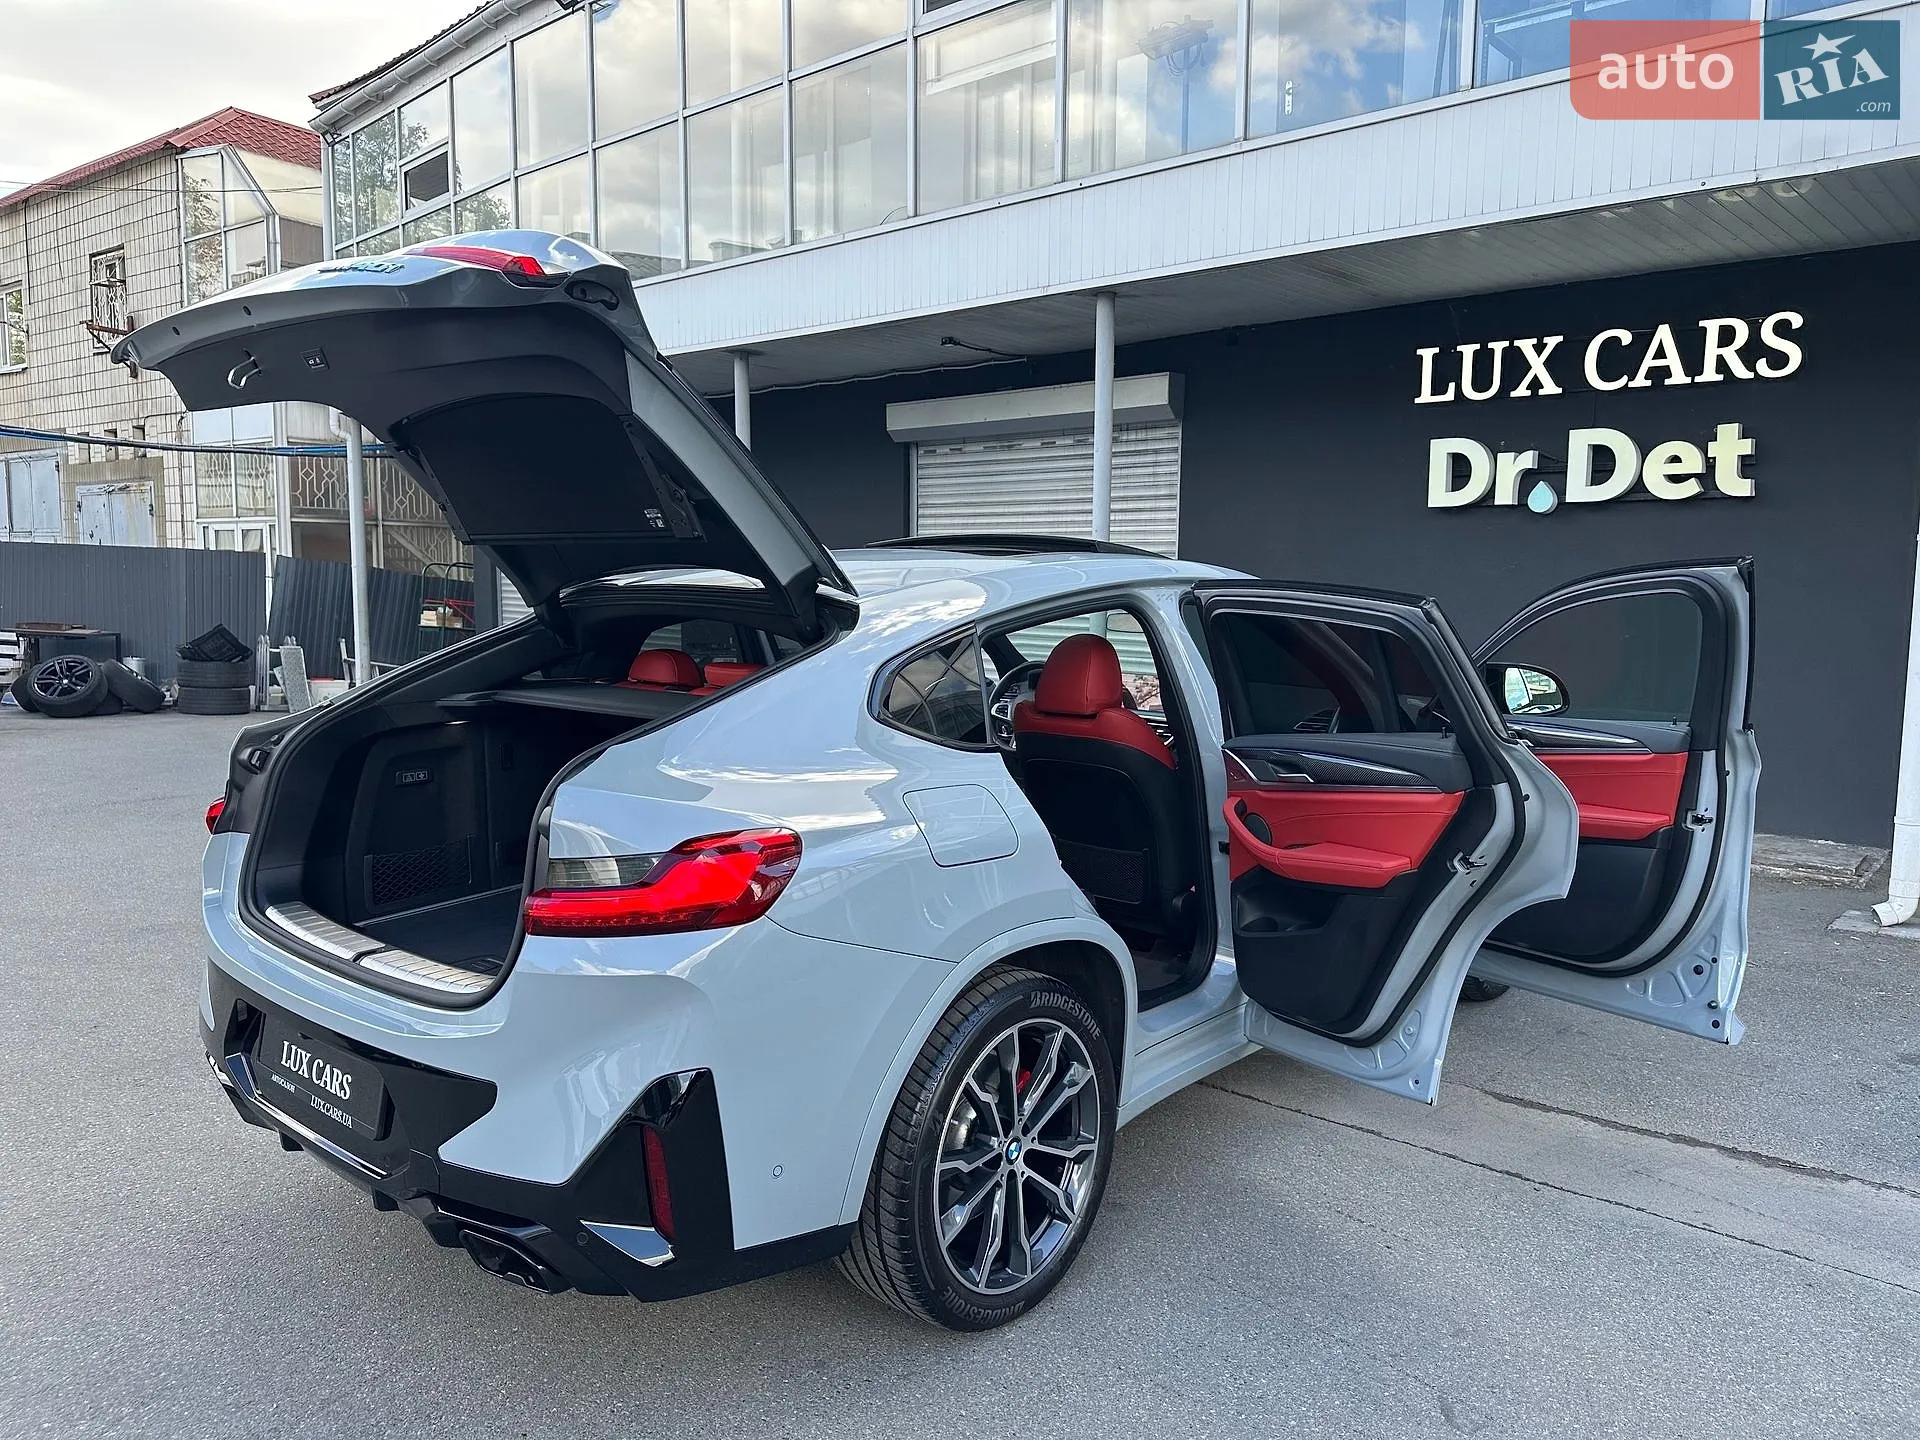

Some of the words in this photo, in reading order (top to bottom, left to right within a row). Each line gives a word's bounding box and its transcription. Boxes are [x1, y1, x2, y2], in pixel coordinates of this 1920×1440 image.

[1414, 335, 1563, 404] LUX
[1584, 311, 1804, 391] CARS
[1030, 991, 1101, 1040] BRIDGESTONE
[281, 1040, 312, 1079] LUX
[312, 1058, 352, 1100] CARS
